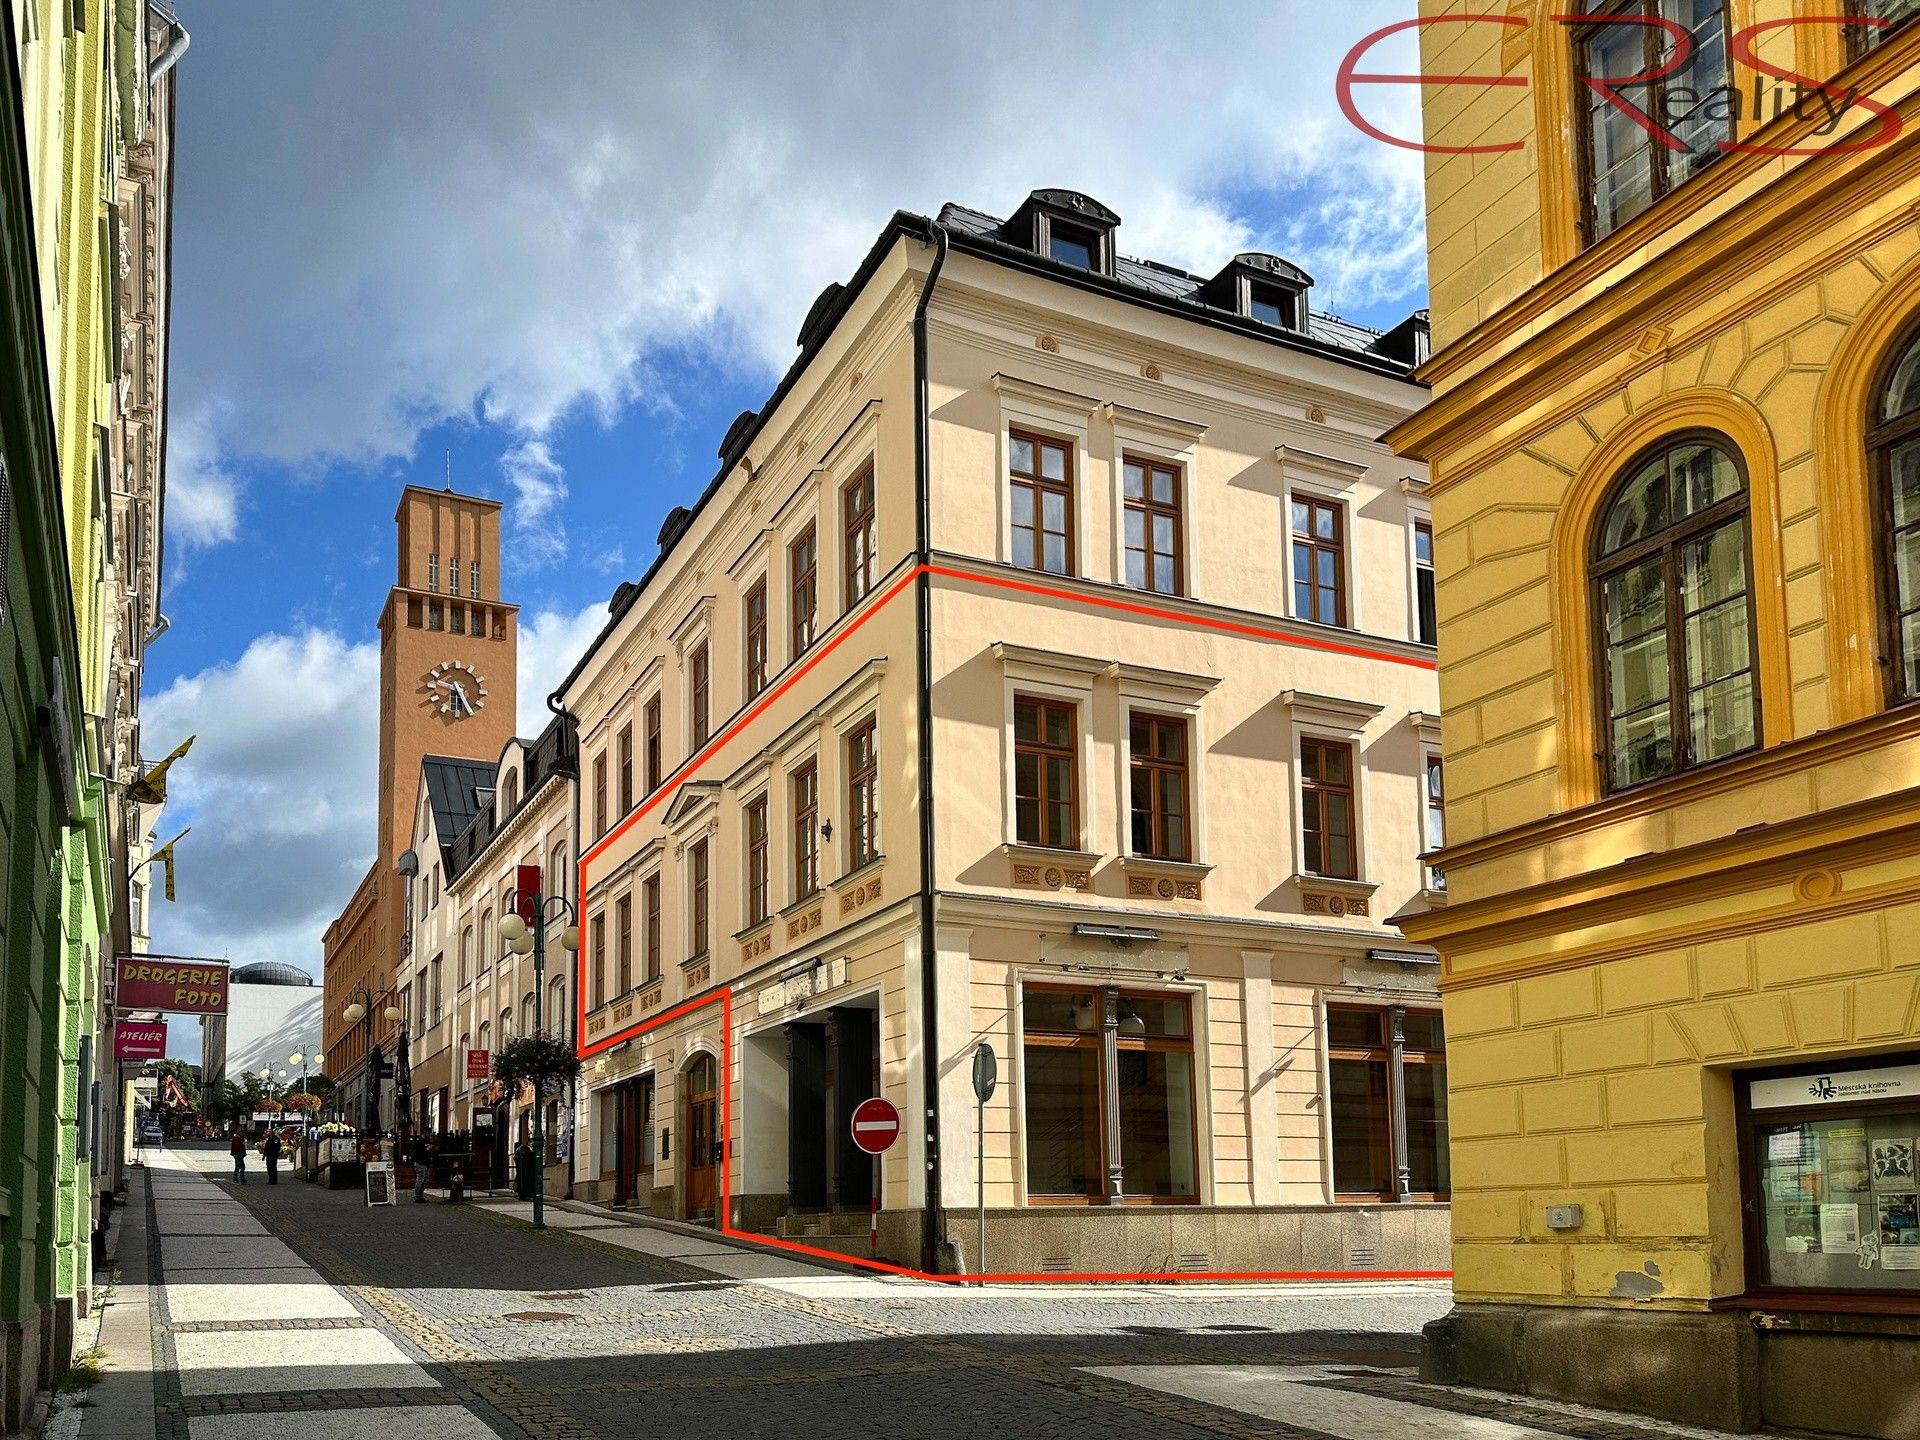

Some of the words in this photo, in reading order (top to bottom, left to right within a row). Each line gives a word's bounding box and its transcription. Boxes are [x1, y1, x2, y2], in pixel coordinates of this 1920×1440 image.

[123, 964, 223, 986] DROGERIE
[174, 988, 222, 1006] FOTO
[1868, 1081, 1901, 1089] knihovna
